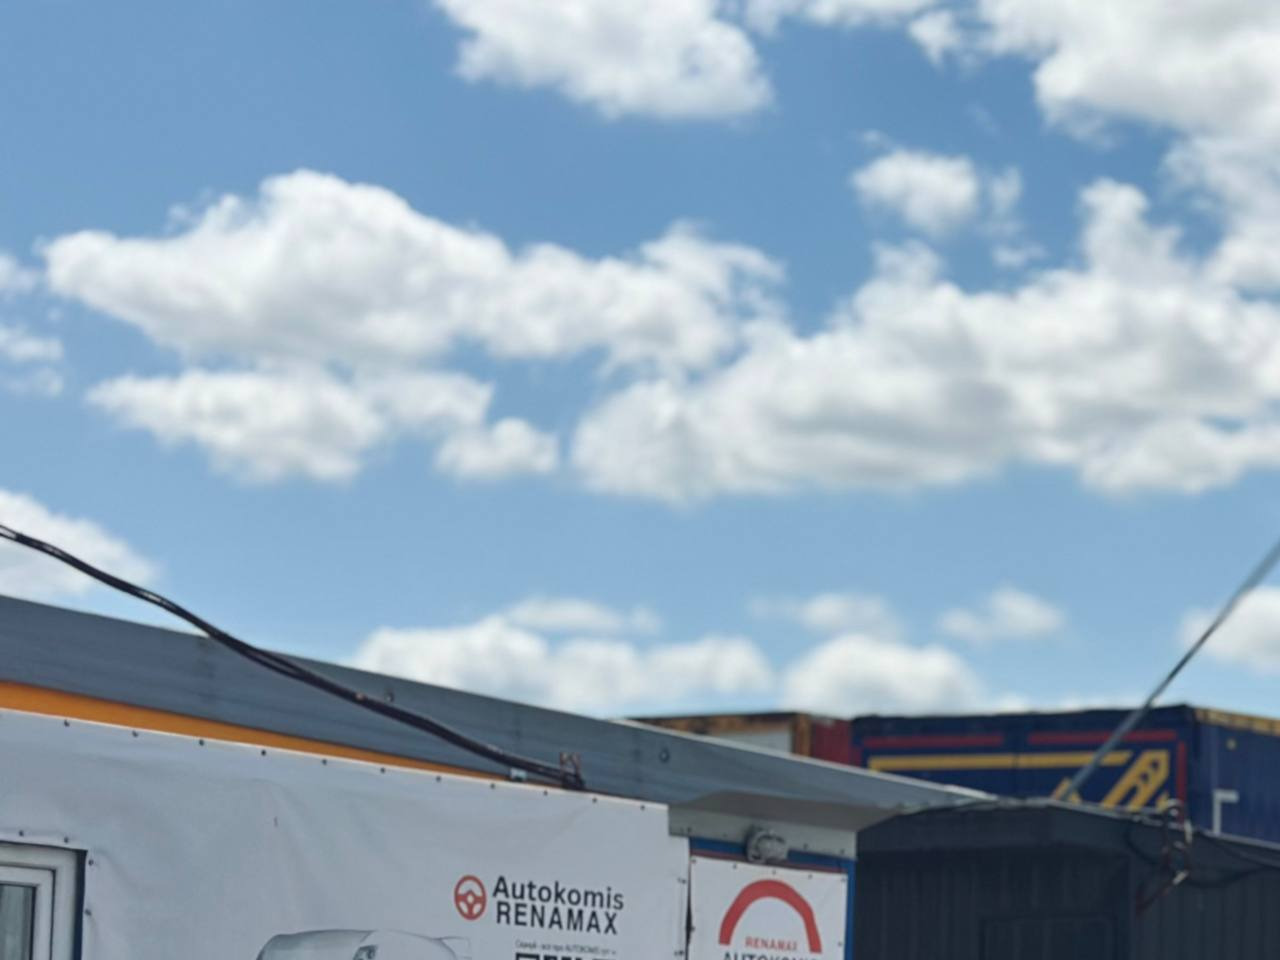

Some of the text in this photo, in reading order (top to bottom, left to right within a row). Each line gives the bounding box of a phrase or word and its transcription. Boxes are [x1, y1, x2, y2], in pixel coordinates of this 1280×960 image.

[492, 876, 624, 911] Autokomis
[496, 901, 618, 935] RENAMAX
[745, 937, 798, 951] RENAMAX
